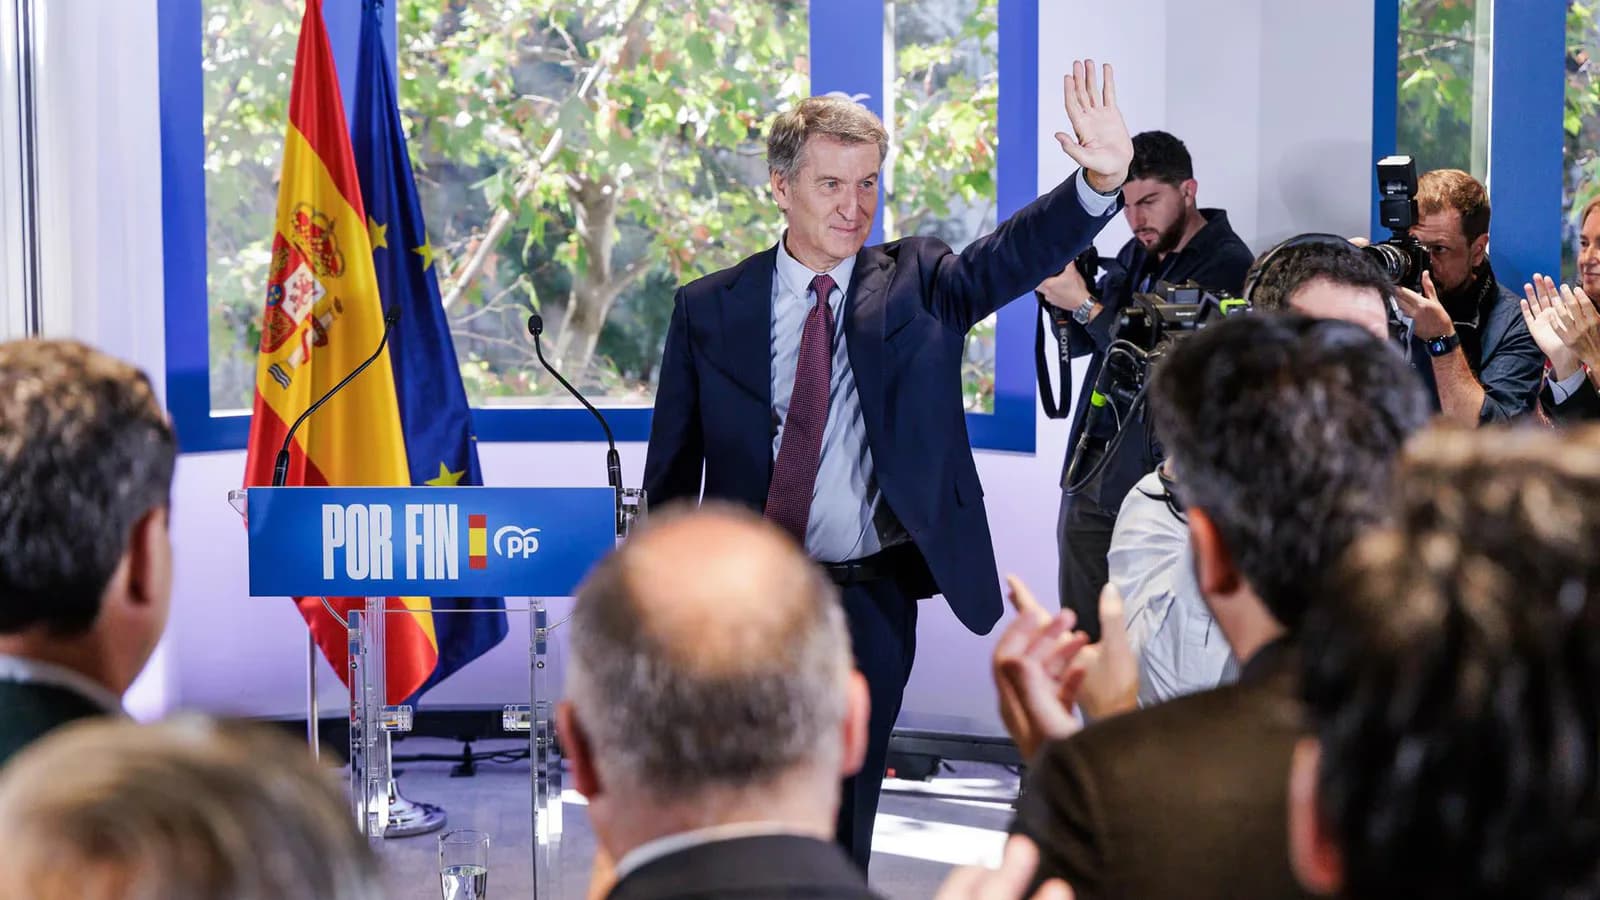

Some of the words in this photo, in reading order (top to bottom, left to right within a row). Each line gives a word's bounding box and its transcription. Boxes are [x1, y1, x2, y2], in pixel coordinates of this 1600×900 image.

[1060, 327, 1069, 363] SONY
[322, 503, 393, 580] POR
[405, 503, 459, 580] FIN
